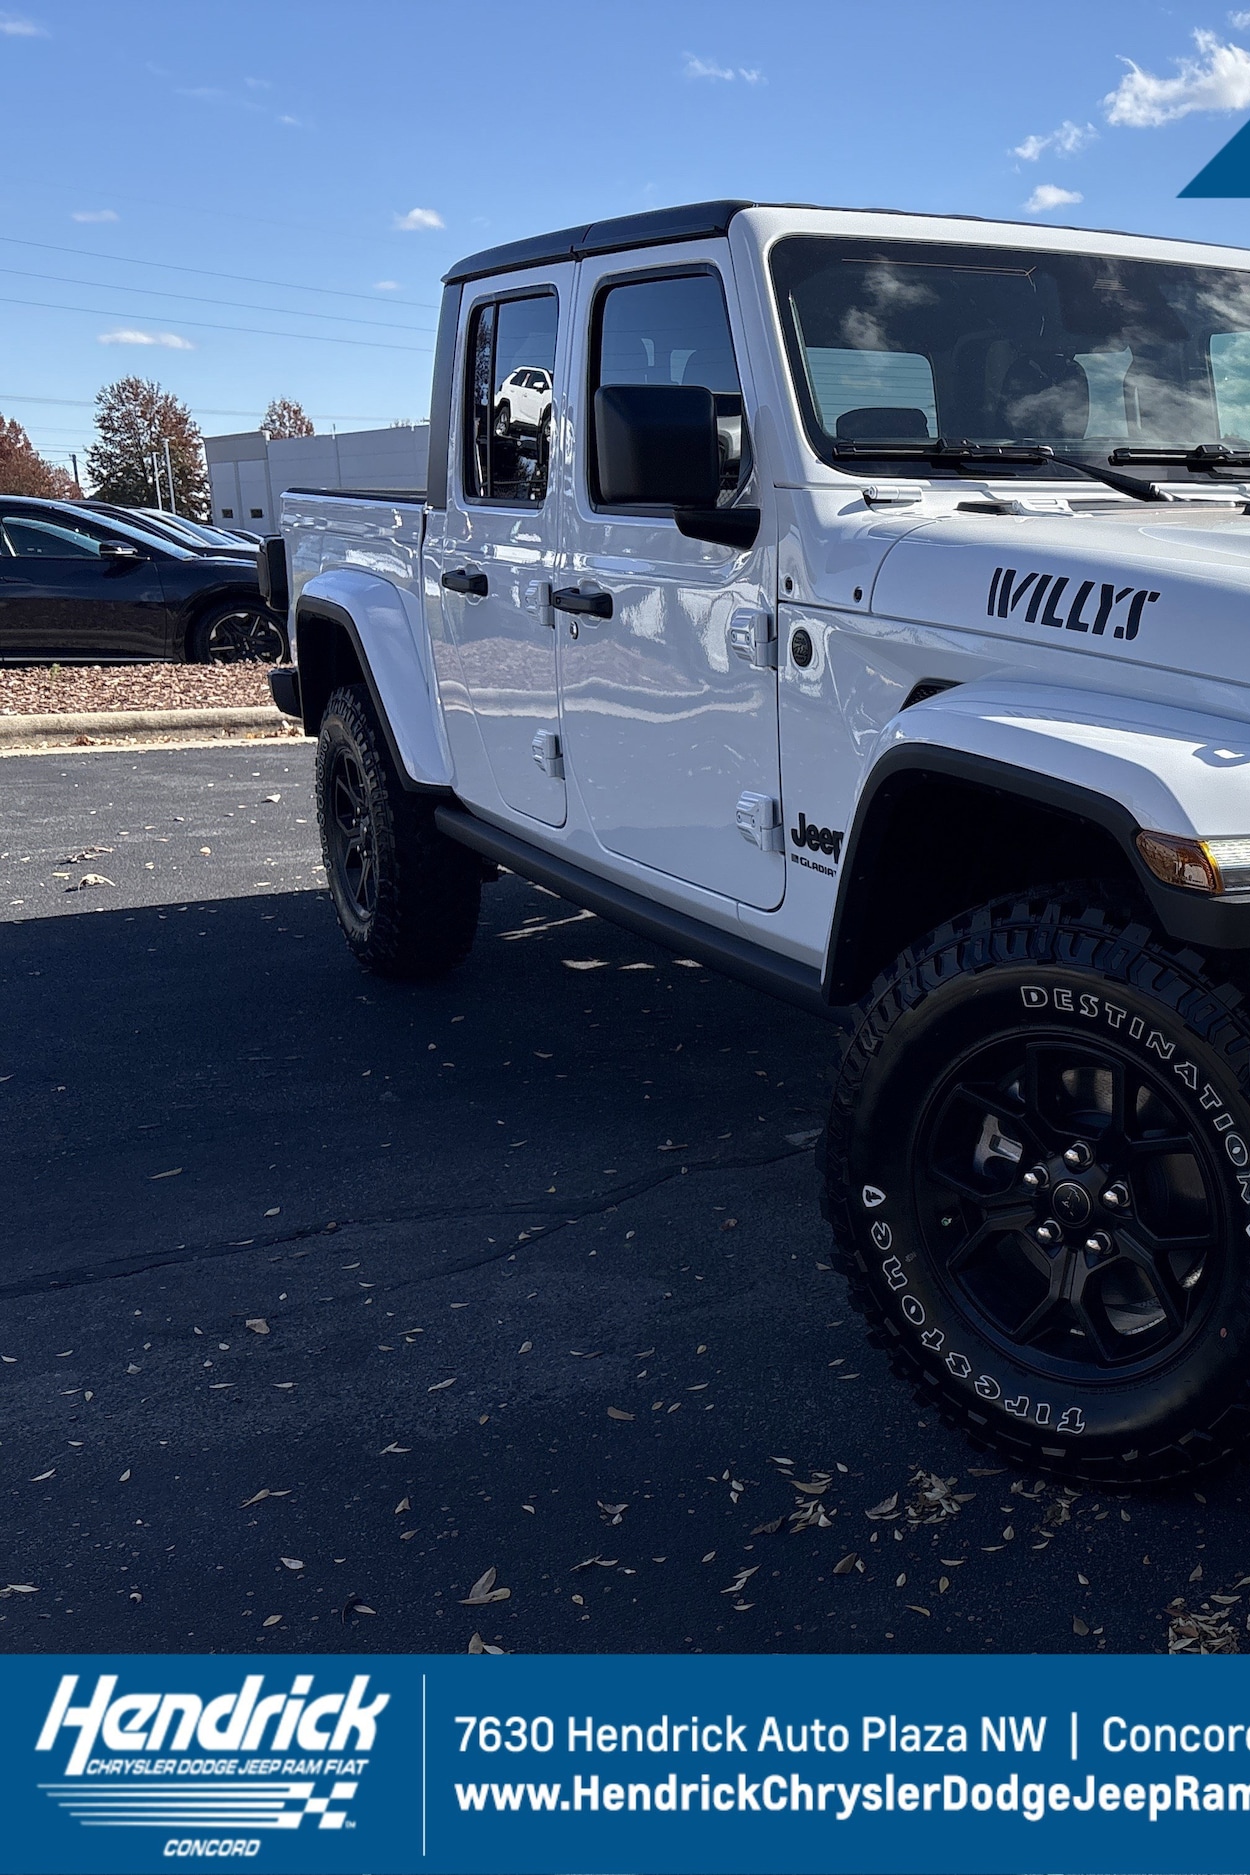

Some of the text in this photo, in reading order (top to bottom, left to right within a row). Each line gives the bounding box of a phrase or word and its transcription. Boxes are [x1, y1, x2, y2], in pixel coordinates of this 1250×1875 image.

[987, 567, 1161, 641] WILLYS
[791, 812, 845, 865] Jeep
[873, 1220, 1086, 1435] Firestone
